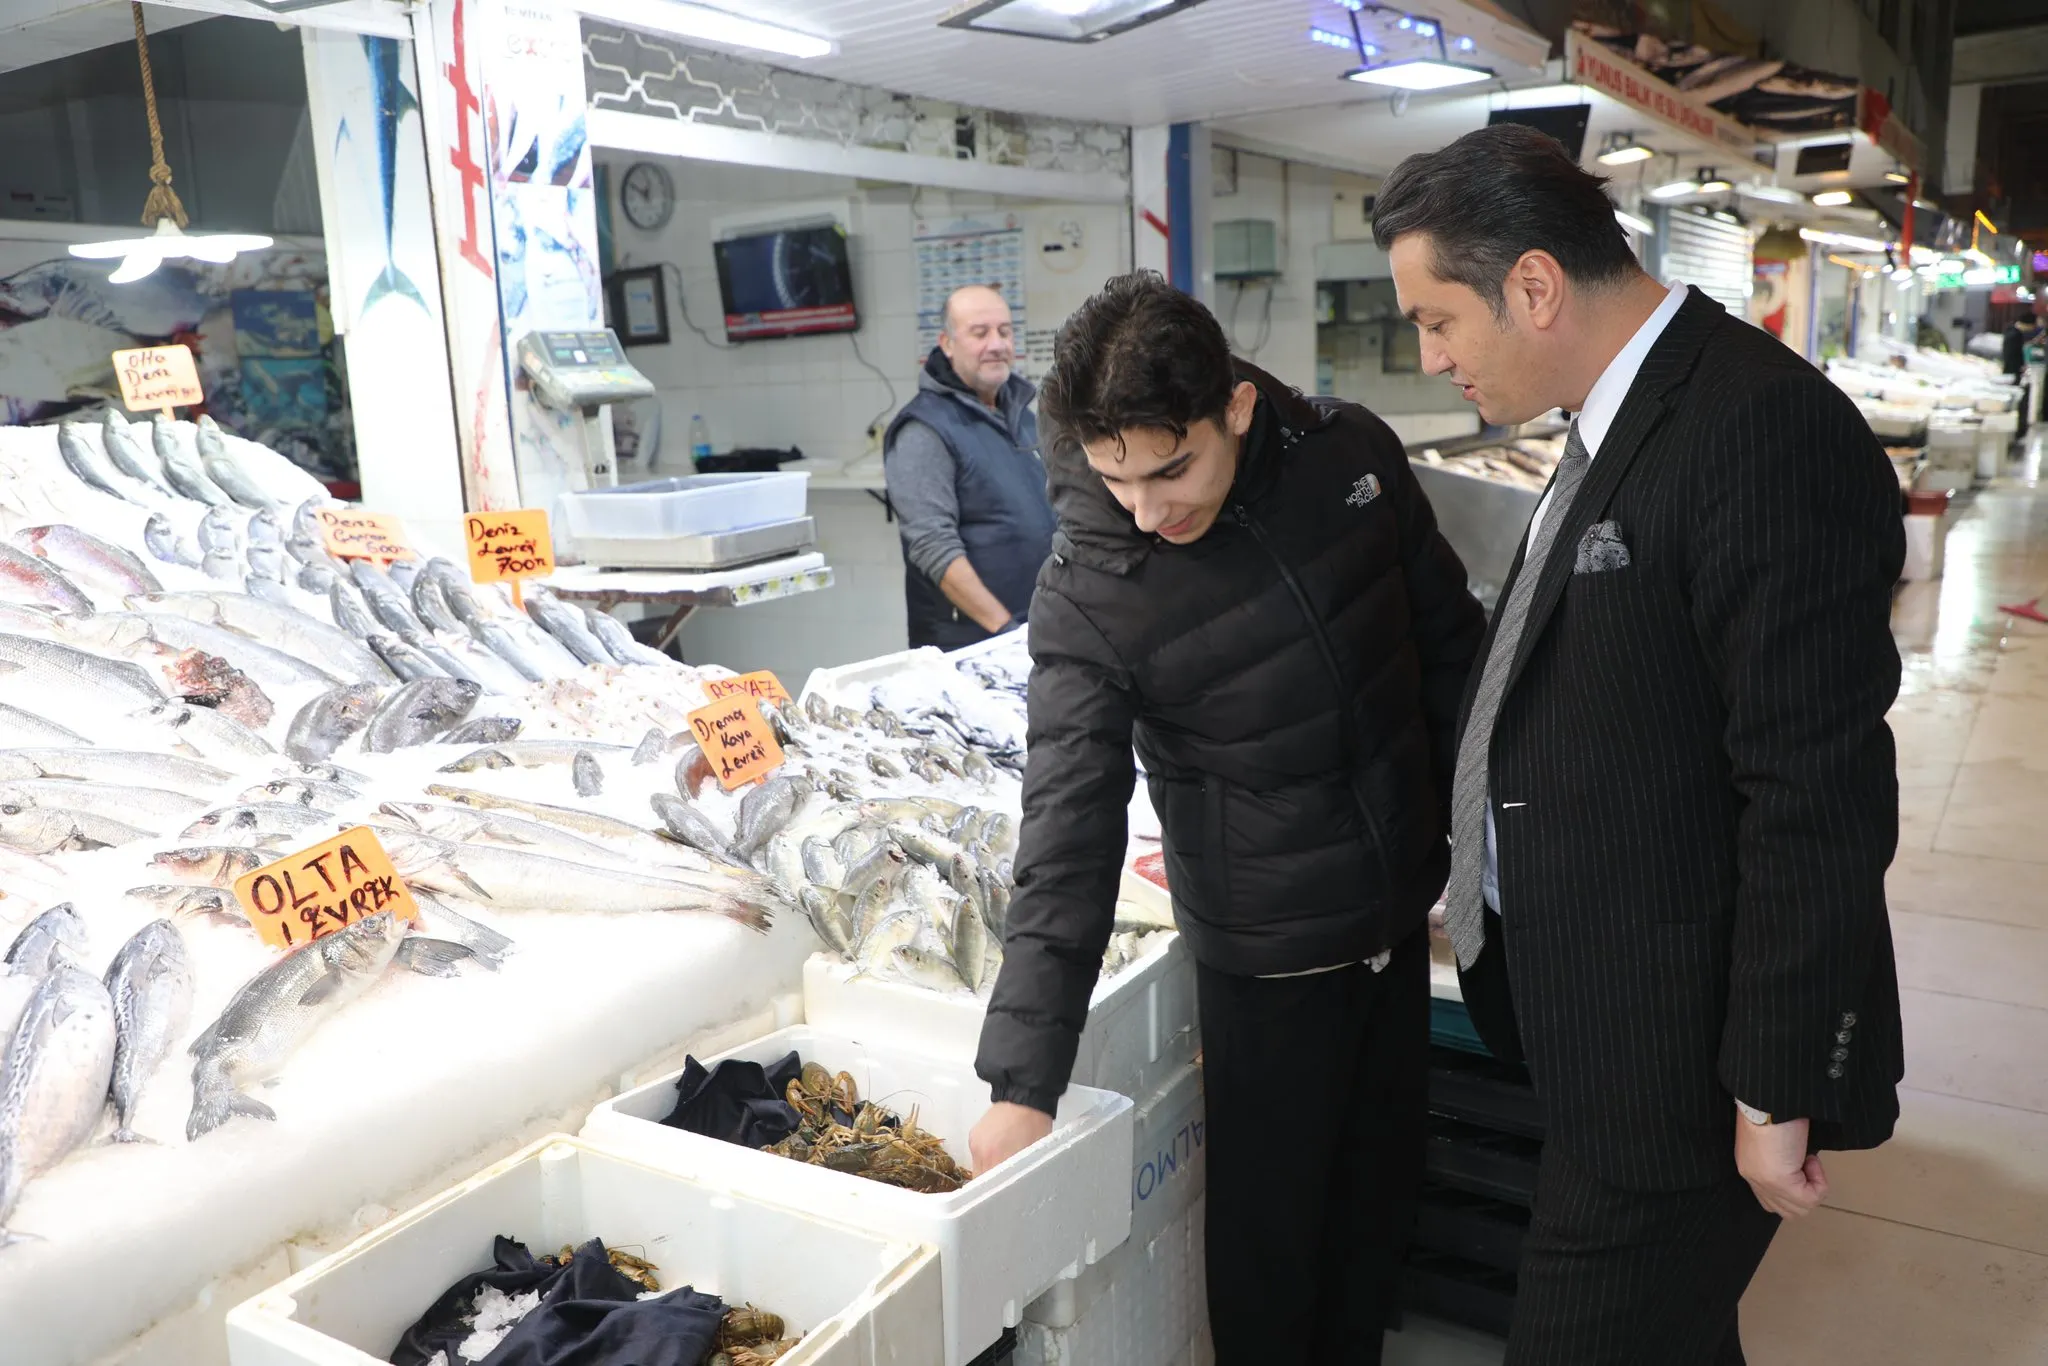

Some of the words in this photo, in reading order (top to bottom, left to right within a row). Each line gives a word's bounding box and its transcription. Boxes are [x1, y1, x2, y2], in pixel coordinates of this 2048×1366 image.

[1352, 477, 1368, 490] THE
[1345, 484, 1372, 506] NORTH
[1357, 493, 1377, 508] FACE
[469, 518, 525, 542] Deniz
[720, 729, 753, 749] Kaya
[251, 844, 371, 915] OLTA
[1136, 1119, 1205, 1201] ALMO
